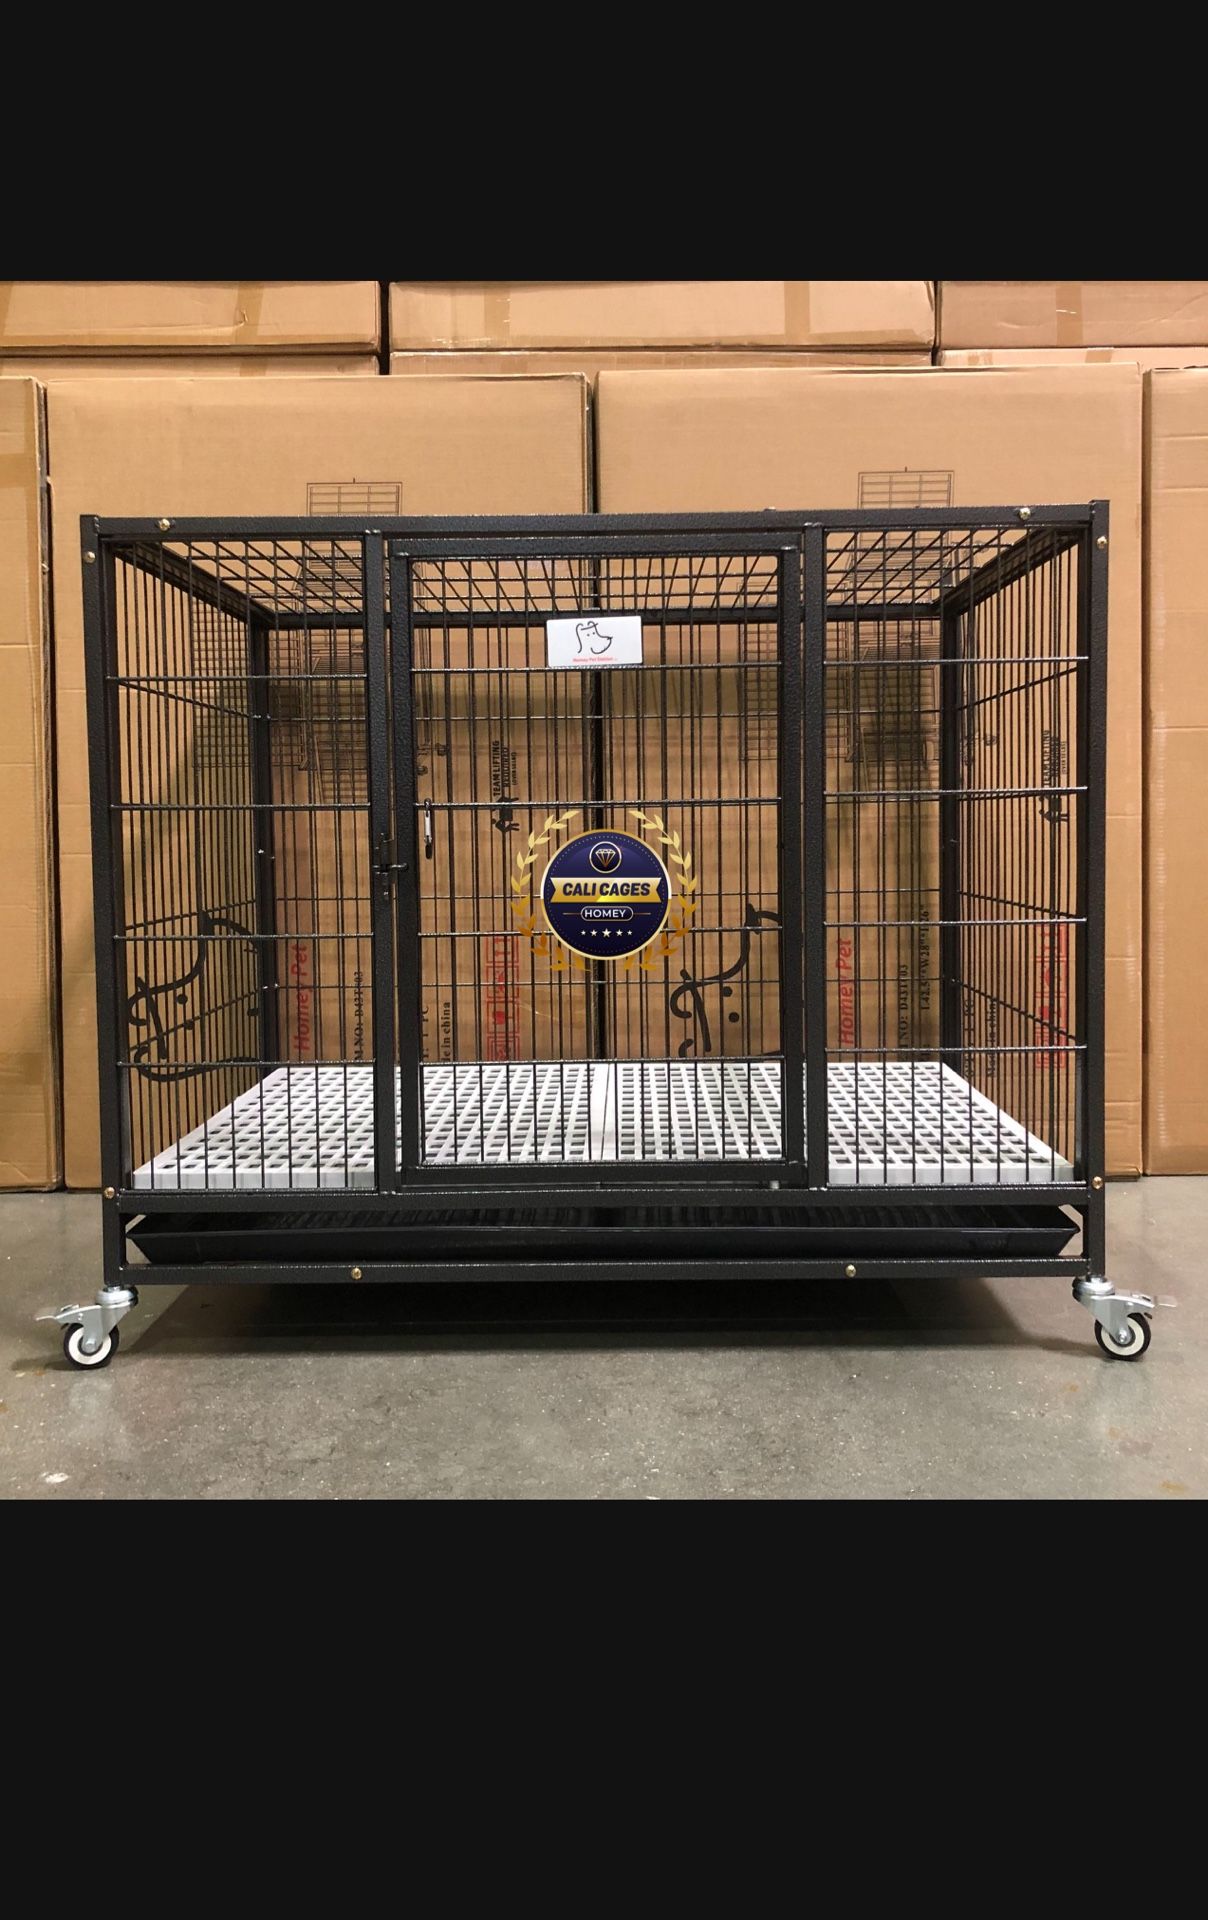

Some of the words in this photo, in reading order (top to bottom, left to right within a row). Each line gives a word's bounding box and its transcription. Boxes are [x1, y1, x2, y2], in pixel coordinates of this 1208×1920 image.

[492, 740, 500, 773] LIFTING
[492, 774, 501, 797] TEAM
[291, 943, 309, 977] Pet
[836, 937, 852, 971] Pet
[293, 984, 313, 1051] Homey
[441, 1002, 451, 1035] china
[839, 975, 855, 1045] Homey
